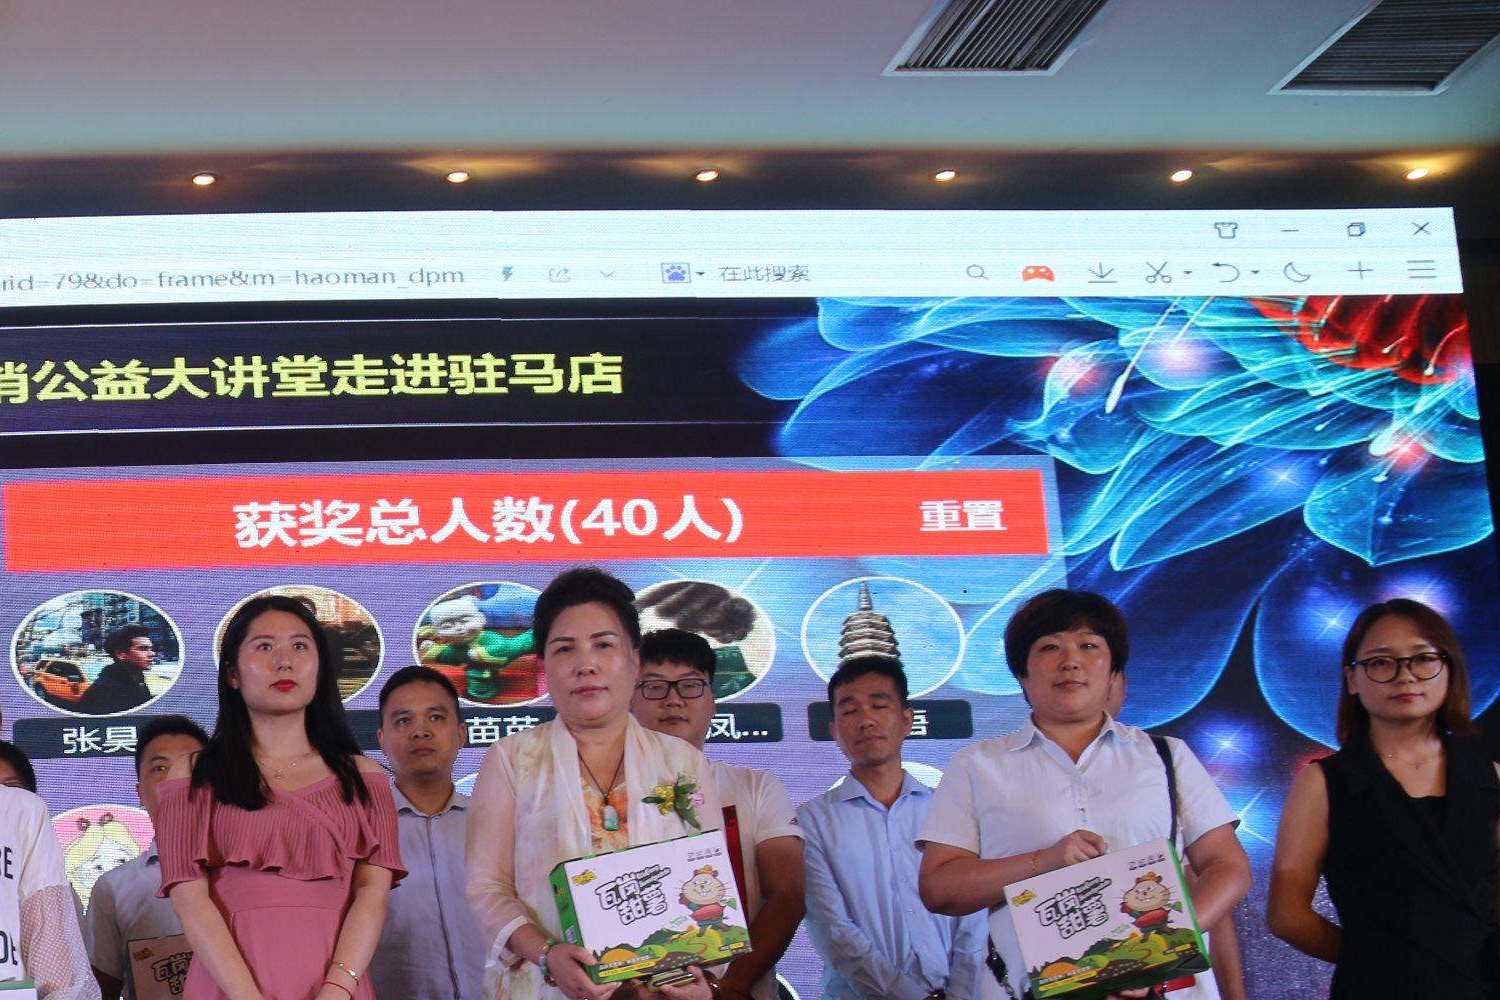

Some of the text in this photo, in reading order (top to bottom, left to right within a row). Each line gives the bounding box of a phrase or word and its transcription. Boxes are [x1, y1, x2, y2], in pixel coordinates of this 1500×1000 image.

[718, 264, 812, 283] 在此搜索
[232, 495, 744, 549] 获奖总人数(40人)
[919, 499, 1008, 532] 重置
[62, 726, 139, 754] 张昊
